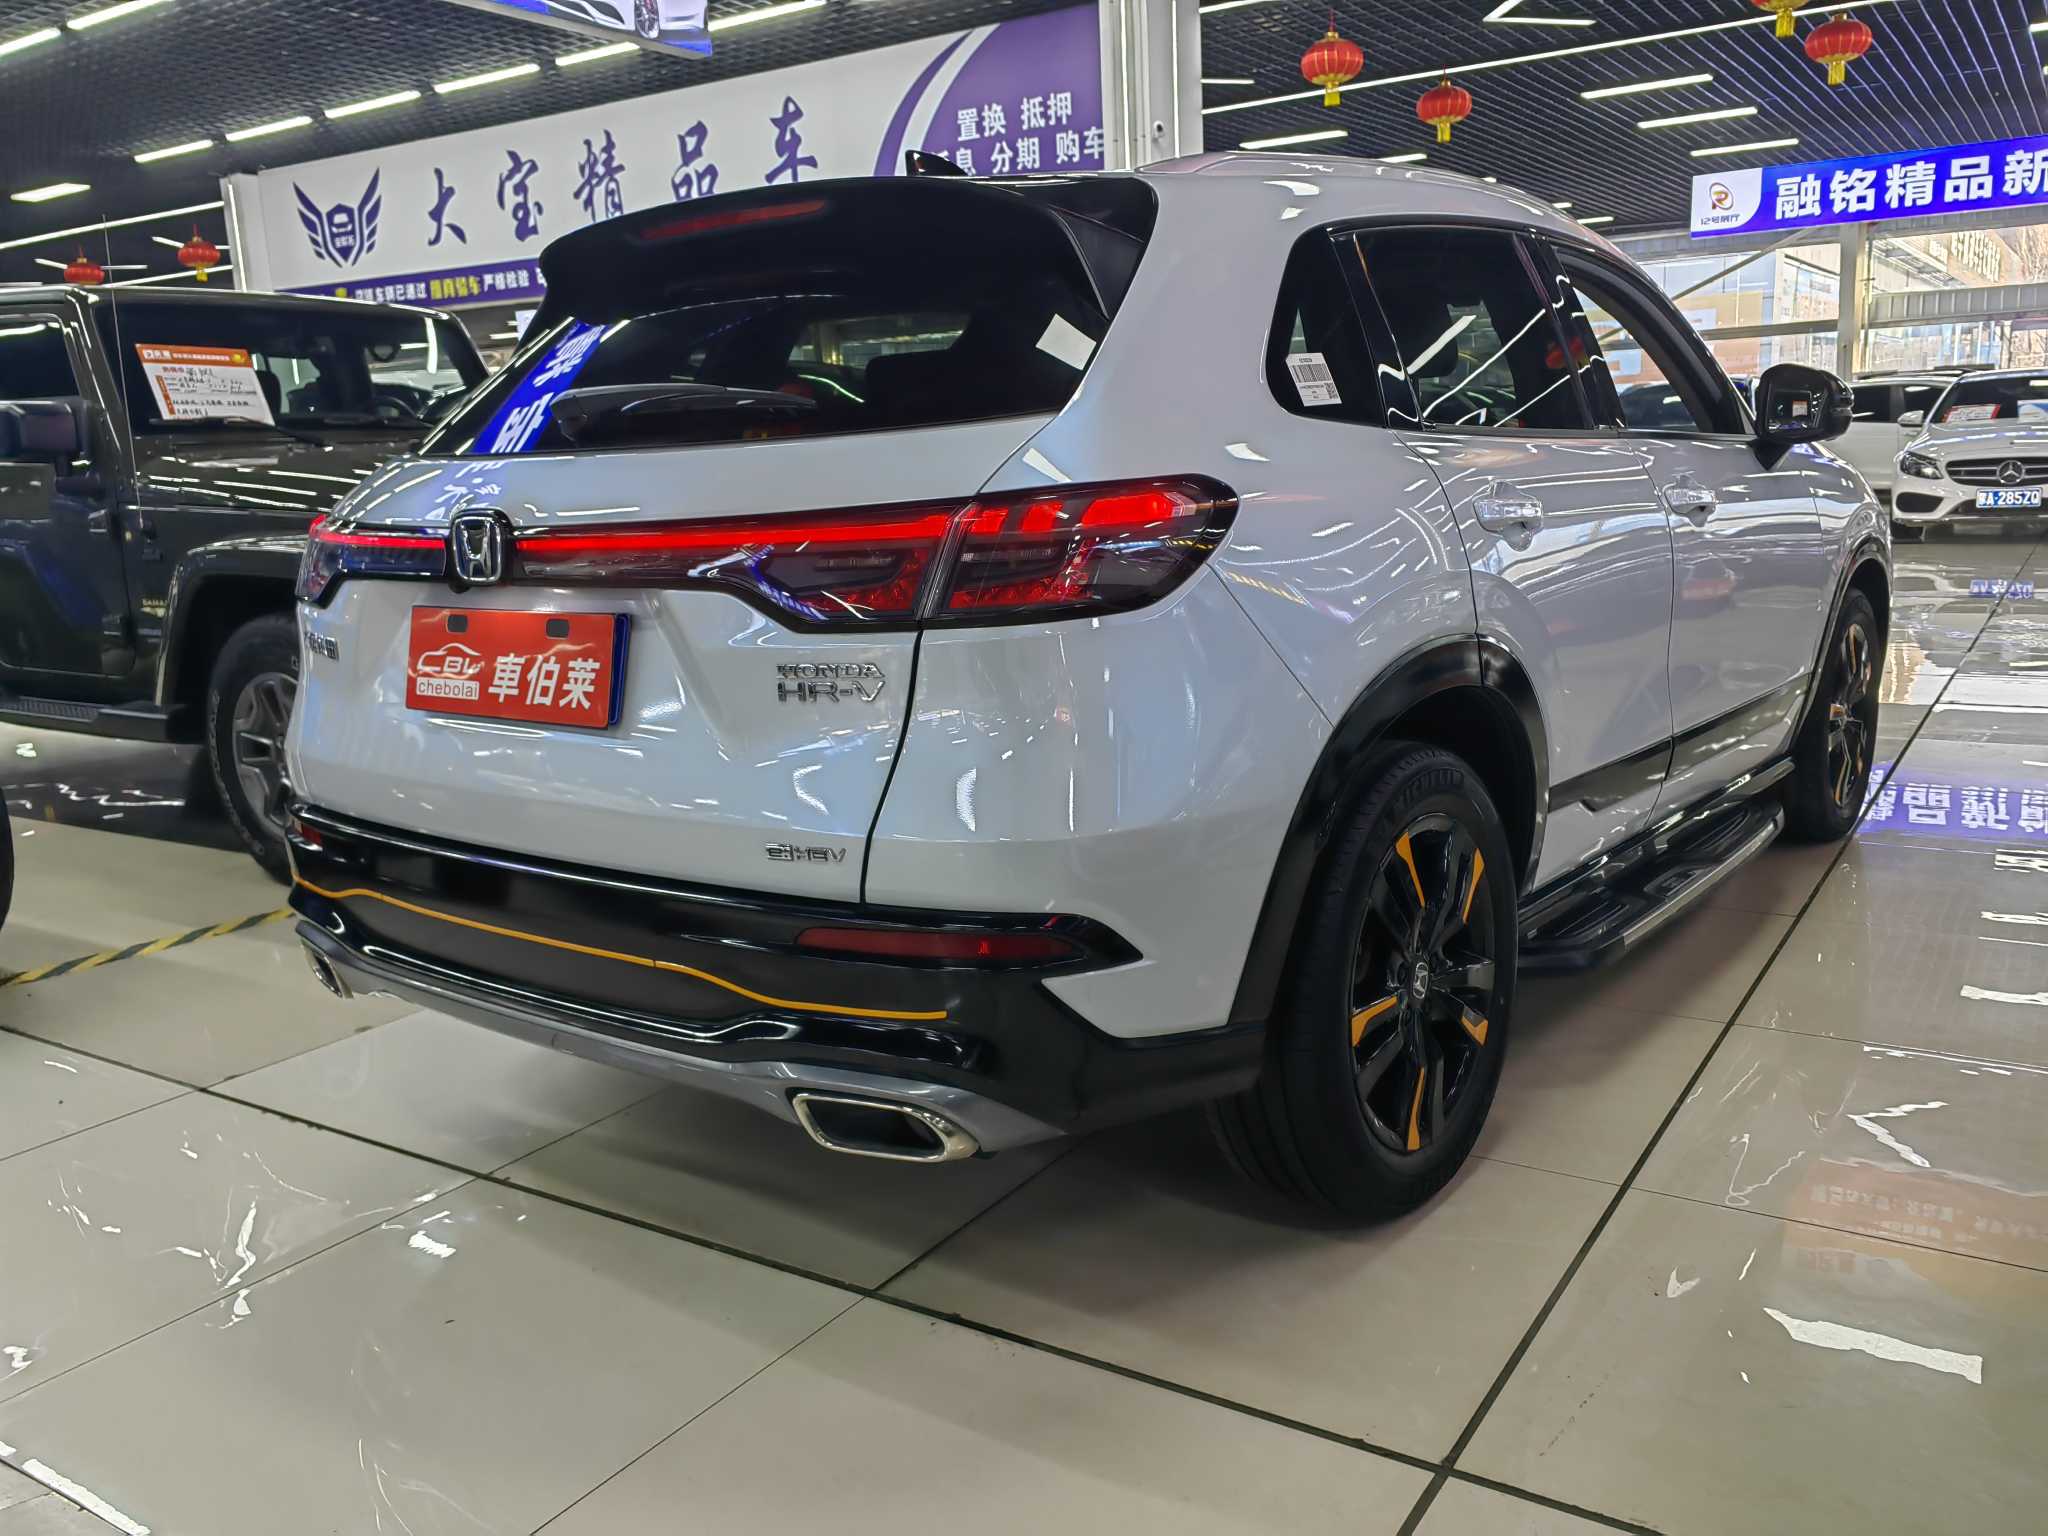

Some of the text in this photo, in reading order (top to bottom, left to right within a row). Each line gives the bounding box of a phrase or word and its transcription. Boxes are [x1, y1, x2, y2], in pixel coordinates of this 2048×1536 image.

[956, 92, 1073, 142] 置换 抵押
[990, 137, 1040, 174] 分期
[1056, 126, 1104, 165] 购车
[1775, 149, 2048, 221] 融铭精品新
[776, 663, 886, 679] HONDA
[417, 680, 479, 699] chebolai
[777, 681, 886, 703] HR-V
